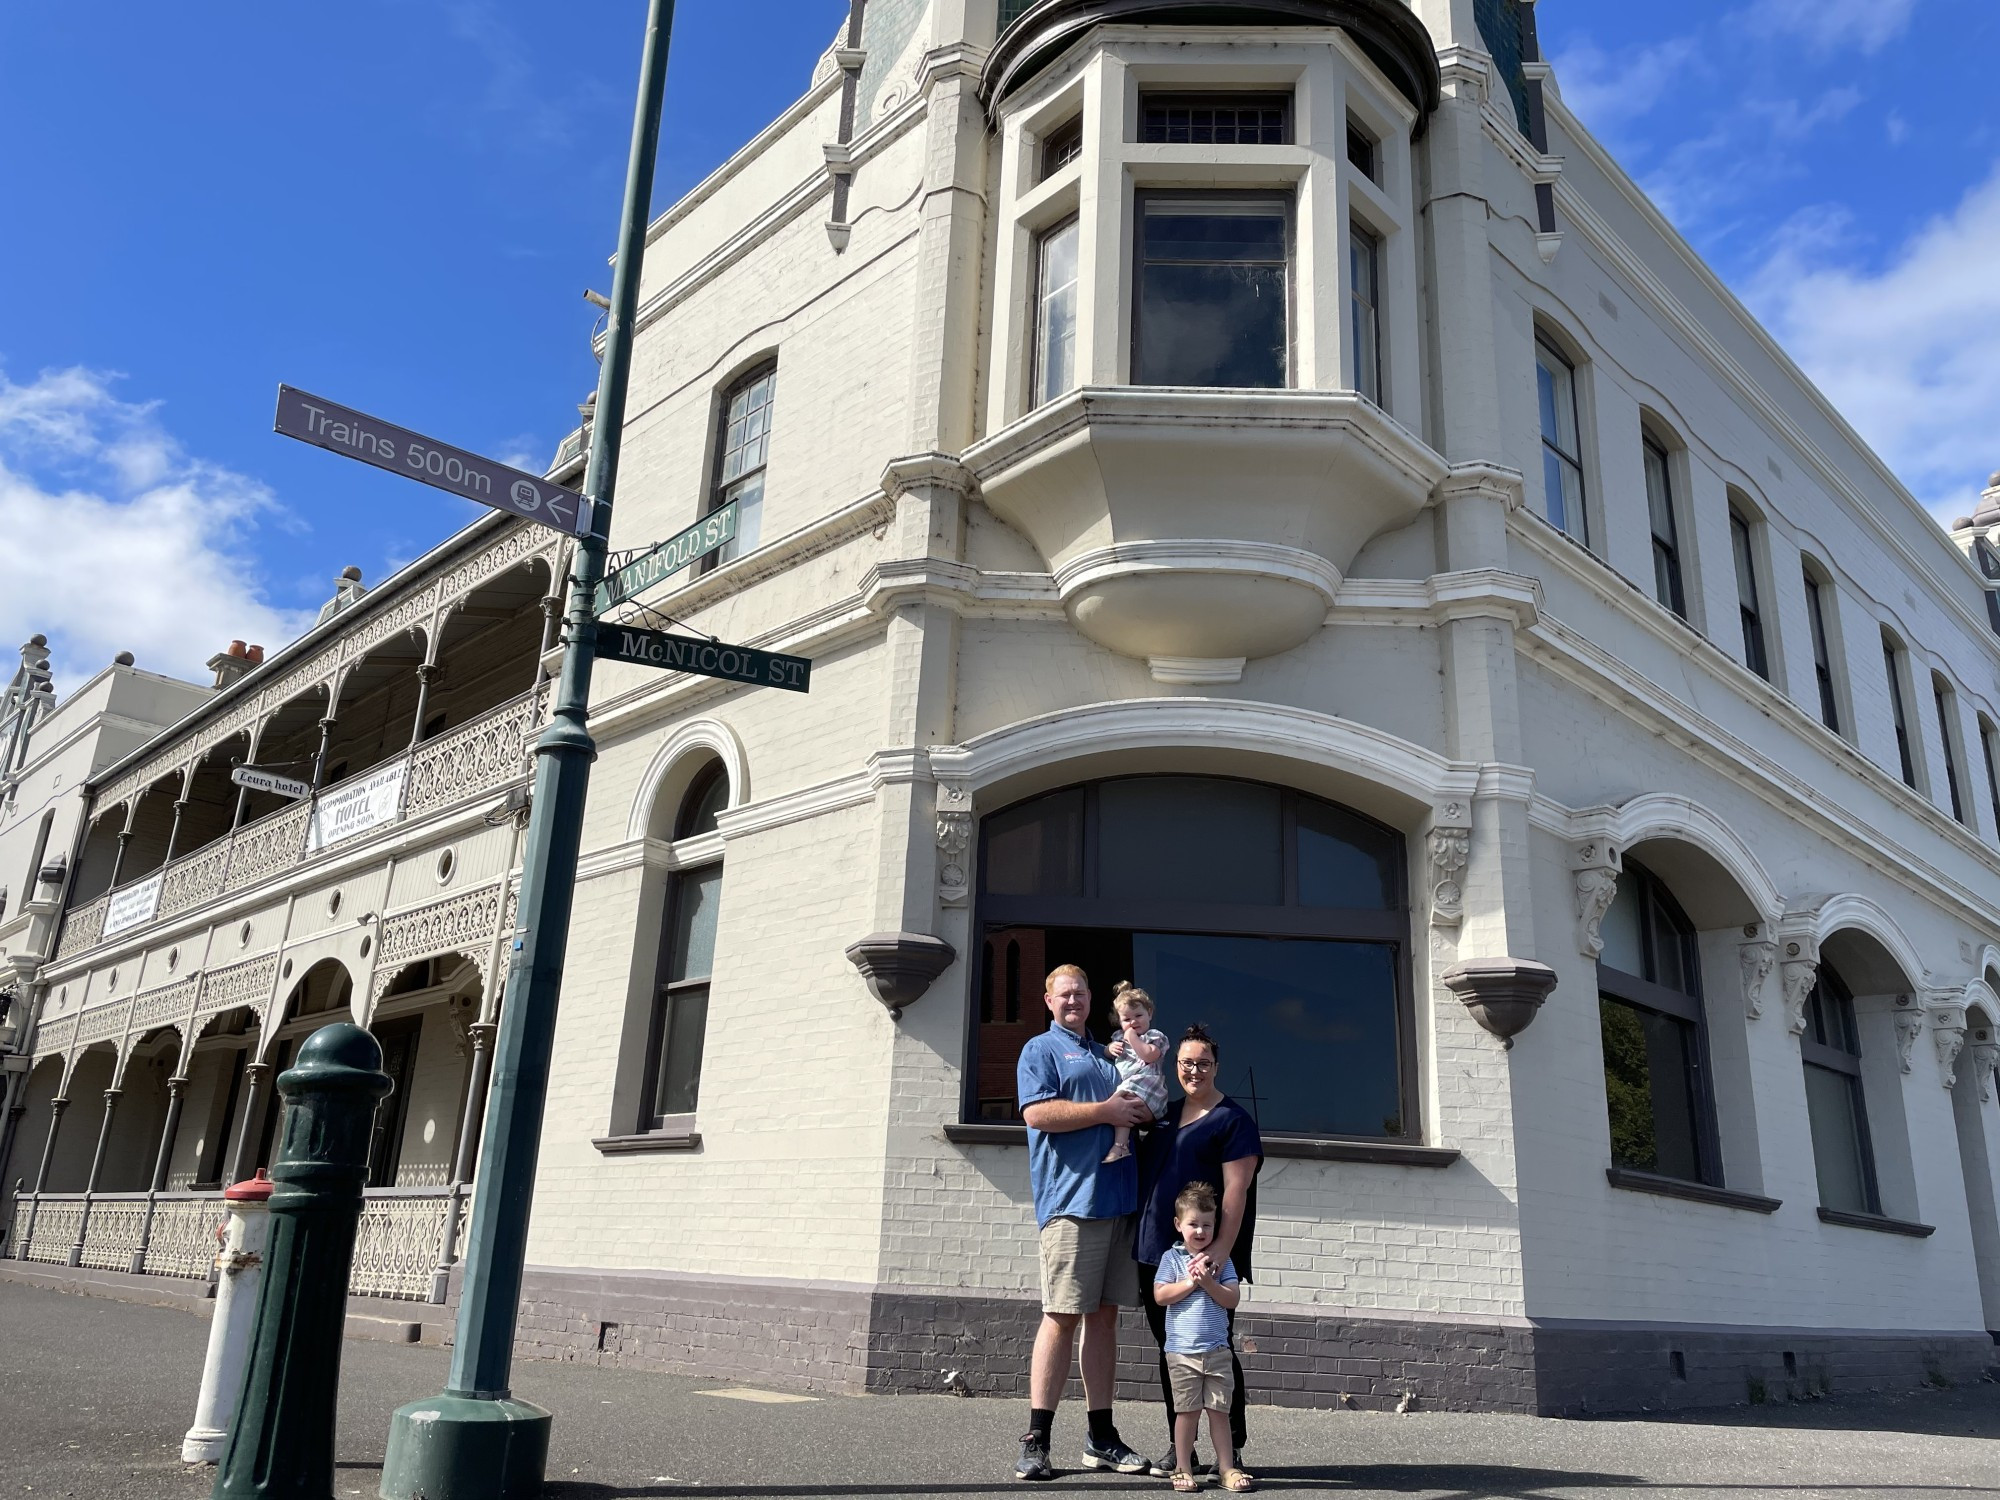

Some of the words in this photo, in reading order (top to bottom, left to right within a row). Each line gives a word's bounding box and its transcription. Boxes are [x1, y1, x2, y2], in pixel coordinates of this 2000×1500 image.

[302, 403, 395, 459] Trains
[406, 443, 491, 494] 500m
[605, 529, 700, 605] MANIFOLD
[705, 509, 731, 549] ST
[619, 632, 757, 679] McNICOL
[768, 658, 804, 686] ST
[274, 779, 304, 795] hotel
[319, 785, 367, 812] CCOMMODATION
[327, 820, 355, 839] OPENING
[356, 812, 376, 827] SOON
[335, 795, 371, 826] HOTEL
